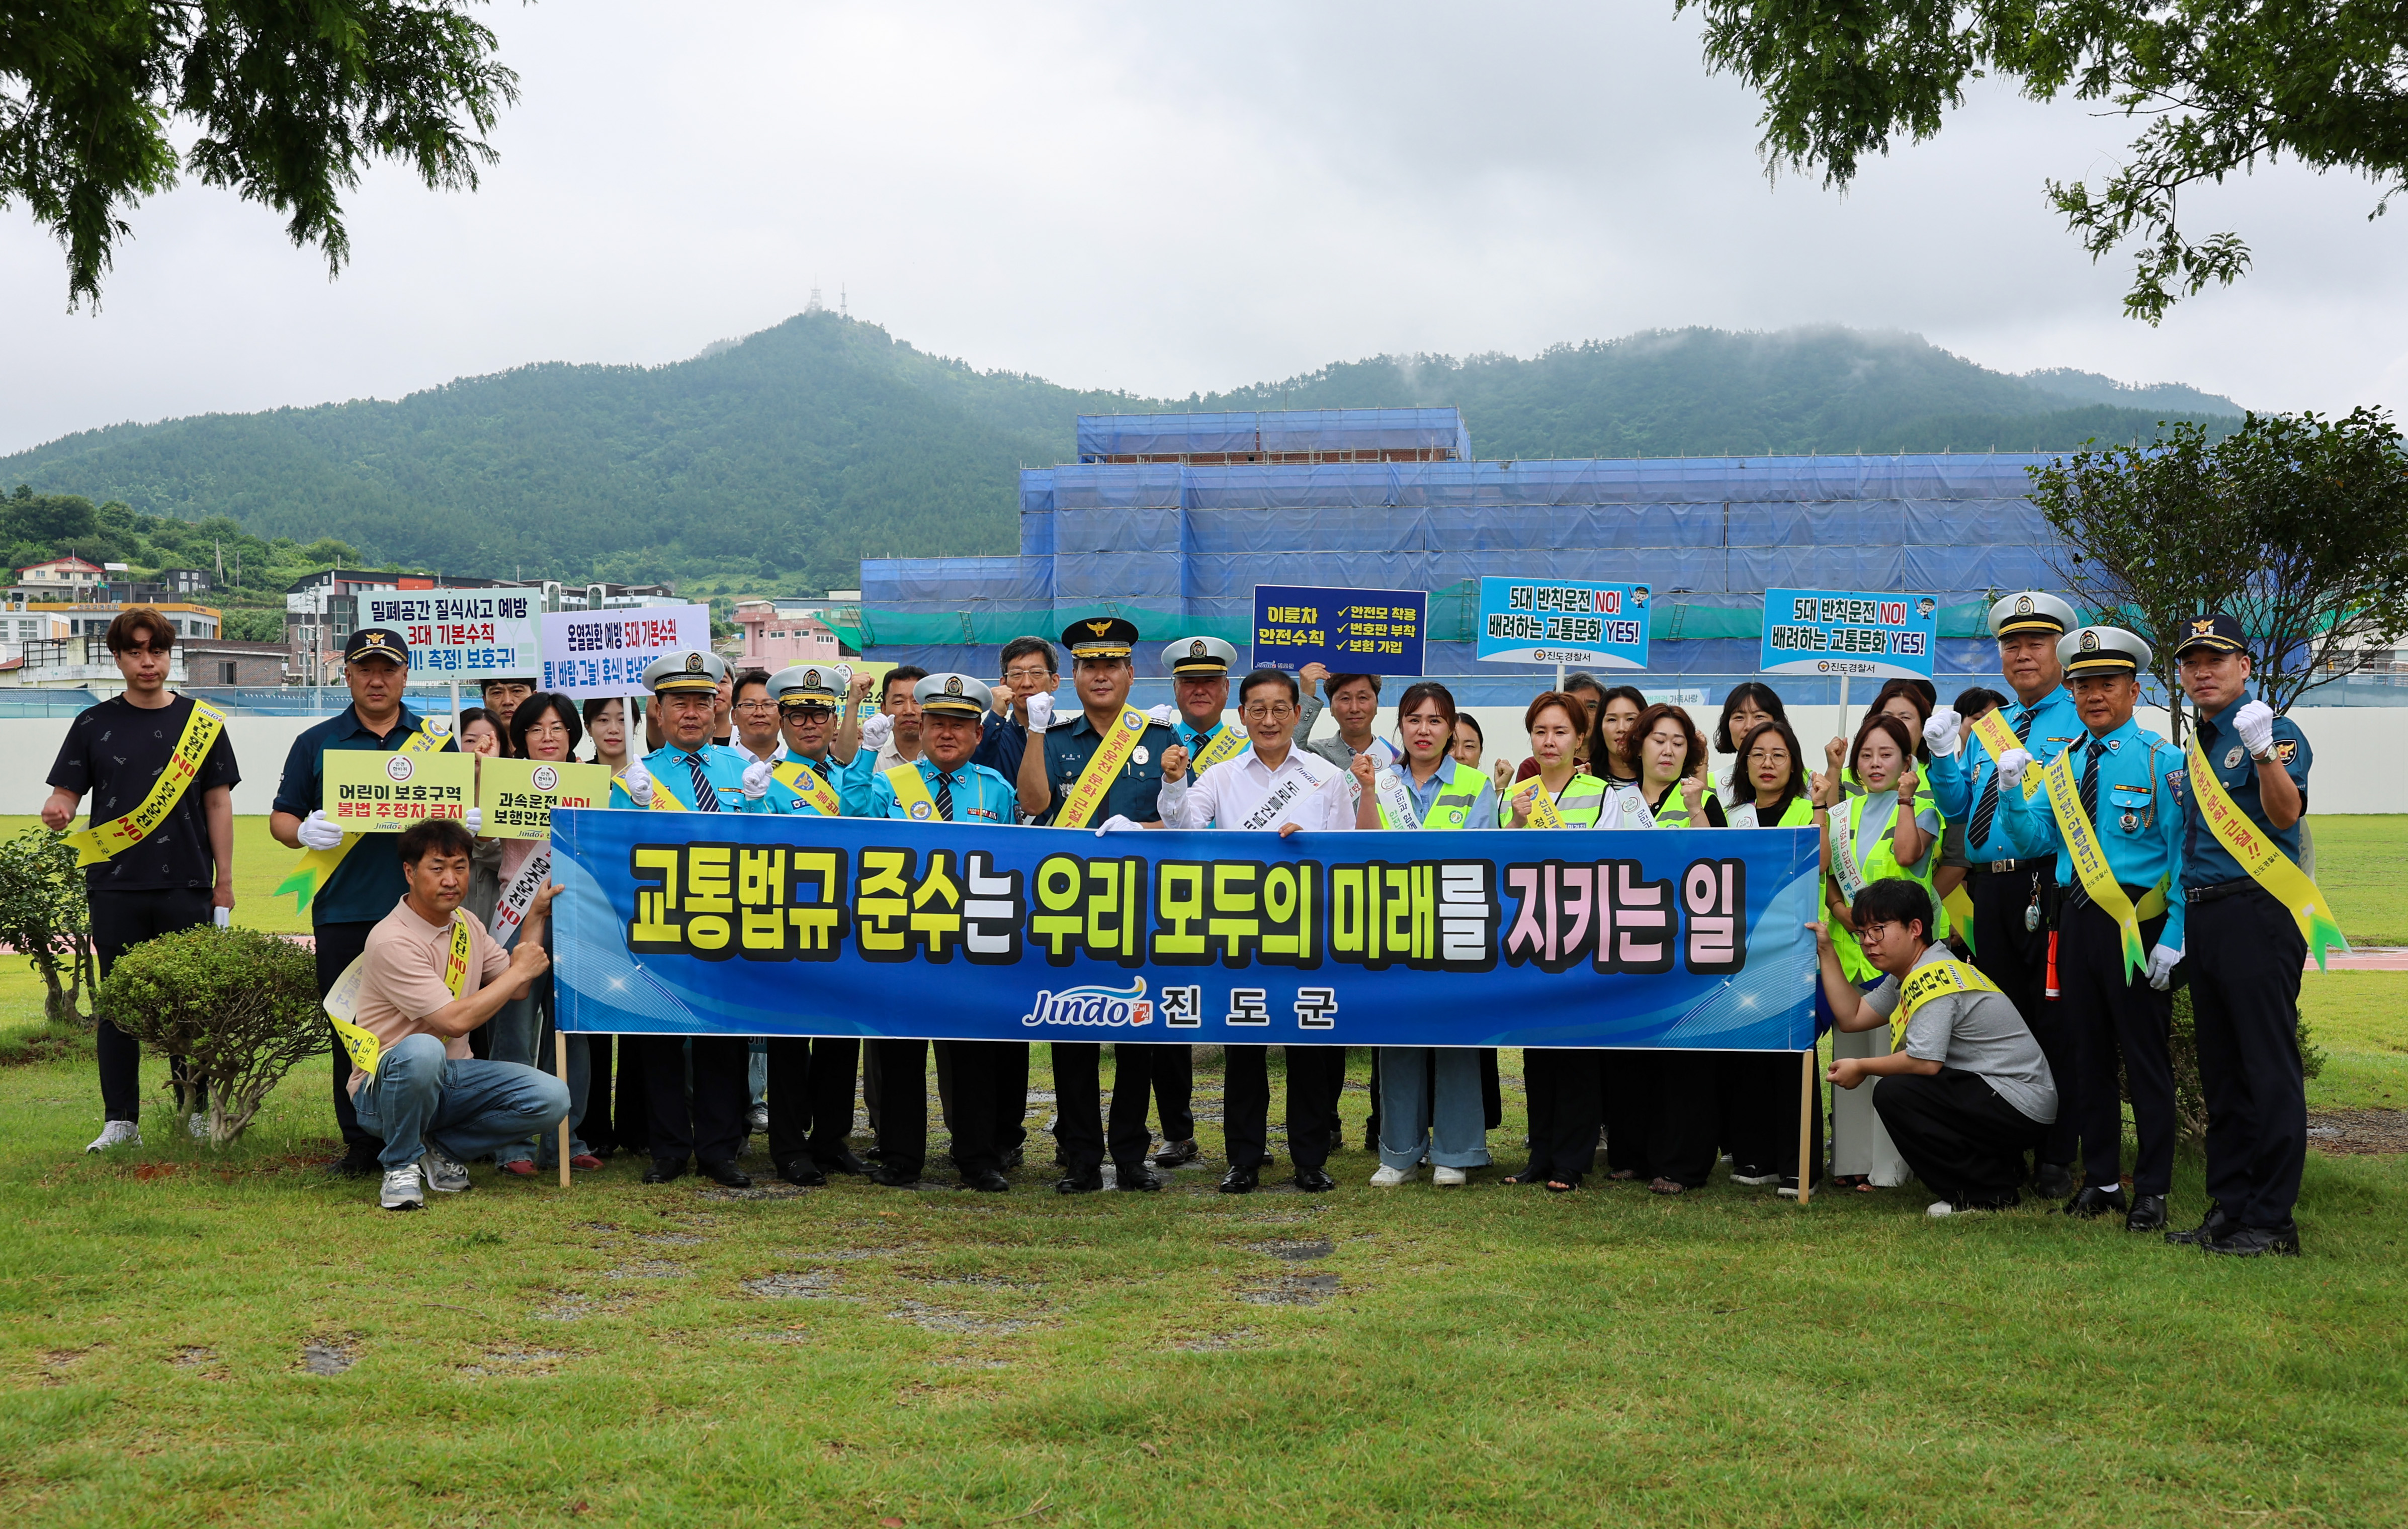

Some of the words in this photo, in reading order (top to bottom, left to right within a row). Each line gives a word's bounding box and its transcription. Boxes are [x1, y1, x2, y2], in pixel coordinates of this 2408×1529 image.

[371, 600, 431, 622] 밀폐공간
[435, 599, 494, 620] 질식사고
[498, 598, 528, 619] 예방
[1510, 587, 1533, 610] 5대
[1537, 587, 1591, 612] 반칙운전
[1595, 591, 1620, 614] NO!
[1794, 599, 1817, 621] 5대
[1822, 599, 1876, 623] 반칙운전
[1879, 603, 1906, 625] NO!
[1267, 607, 1318, 624] 이륜차
[1351, 606, 1388, 619] 안전모
[1392, 608, 1416, 621] 착용
[407, 625, 433, 645] 3대
[437, 623, 495, 644] 기본수칙
[568, 623, 603, 651] 온열질환
[605, 622, 622, 649] 예방
[625, 621, 640, 648] 5대
[642, 619, 677, 647] 기본수칙
[1259, 629, 1324, 647] 안전수칙
[1350, 623, 1387, 636] 번호판
[1391, 624, 1416, 637] 부착
[1489, 615, 1543, 638] 배려하는
[1546, 618, 1601, 642] 교통문화
[1606, 621, 1639, 644] YES!
[1772, 626, 1827, 650] 배려하는
[1831, 629, 1886, 653] 교통문화
[1890, 632, 1925, 655] YES!
[1349, 639, 1373, 652] 보험
[1378, 641, 1402, 654] 가입
[1547, 651, 1591, 661] 진도경찰서
[408, 649, 423, 671] 기!
[428, 649, 461, 670] 측정!
[467, 648, 515, 668] 보호구!
[1831, 662, 1875, 672] 진도경찰서
[544, 661, 556, 689] 물!
[603, 657, 623, 685] 휴식!
[1645, 695, 1668, 704] 번점검
[196, 707, 219, 720] Jindo
[184, 716, 213, 762] 무단횡단
[1097, 729, 1131, 775] 음주운전
[1081, 773, 1103, 798] 문화
[1295, 767, 1317, 784] Jindo
[339, 785, 389, 800] 어린이
[395, 785, 461, 801] 보호구역
[499, 793, 557, 809] 과속운전
[1394, 789, 1408, 812] 군민과
[136, 781, 176, 829] 음주운전
[338, 802, 370, 817] 불법
[376, 803, 426, 818] 주정차
[431, 804, 462, 819] 금지
[2207, 794, 2228, 823] 문화
[2050, 764, 2069, 801] 배려하는
[2060, 798, 2076, 819] 당신
[2068, 817, 2099, 874] 아름답습니다
[517, 830, 540, 838] Jindo
[2253, 852, 2280, 877] 진도경찰서
[509, 857, 551, 909] 음주운전
[2087, 869, 2109, 889] 진도경찰서
[632, 848, 839, 950] 교통법규
[857, 851, 1014, 954] 준수는
[1033, 857, 1136, 956] 우리
[1156, 862, 1311, 959] 모두의
[1333, 863, 1489, 961] 미래를
[1508, 864, 1666, 963] 지키는
[1687, 864, 1735, 965] 일
[1023, 990, 1123, 1025] Jindo
